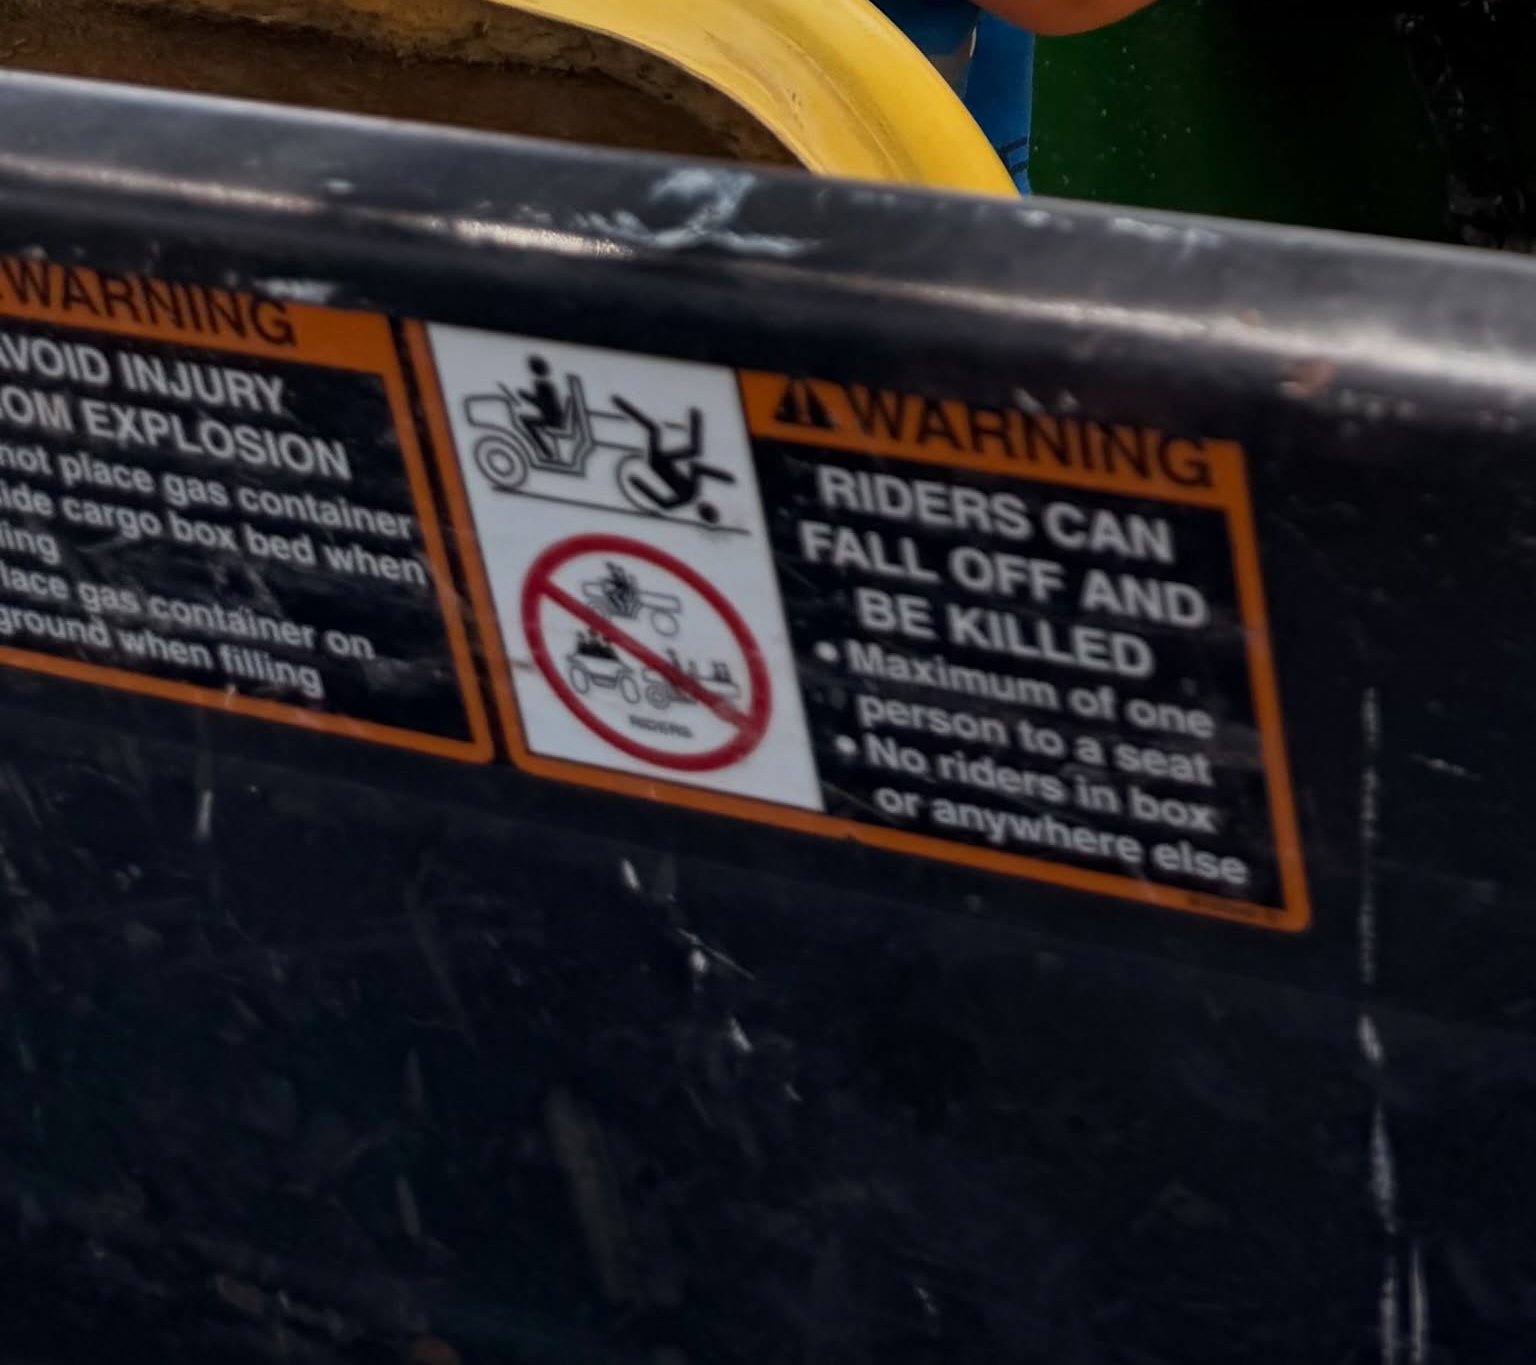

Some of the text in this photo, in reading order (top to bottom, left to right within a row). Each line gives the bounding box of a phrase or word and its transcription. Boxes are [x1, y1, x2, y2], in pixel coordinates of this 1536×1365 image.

[2, 254, 295, 347] WARNING
[118, 352, 284, 414] INJURY
[0, 386, 352, 481] OM EXPLOSION
[846, 381, 1214, 488] WARNING
[59, 452, 154, 494] place
[163, 473, 229, 508] gas
[237, 485, 412, 540] container
[61, 497, 162, 541] cargo
[168, 509, 238, 552] box
[244, 524, 317, 567] bed
[323, 541, 427, 587] when
[816, 464, 1175, 564] RIDERS CAN
[77, 581, 141, 615] gas
[149, 595, 317, 650] container
[324, 628, 376, 661] on
[800, 520, 1210, 629] FALL OFF AND
[117, 625, 213, 671] when
[218, 642, 325, 701] filling
[856, 586, 1156, 681] BE KILLED
[846, 637, 1217, 739] Maximum of one
[857, 692, 1217, 788] person to a seat
[863, 731, 1218, 836] No riders in box
[874, 786, 1250, 886] or anywhere else
